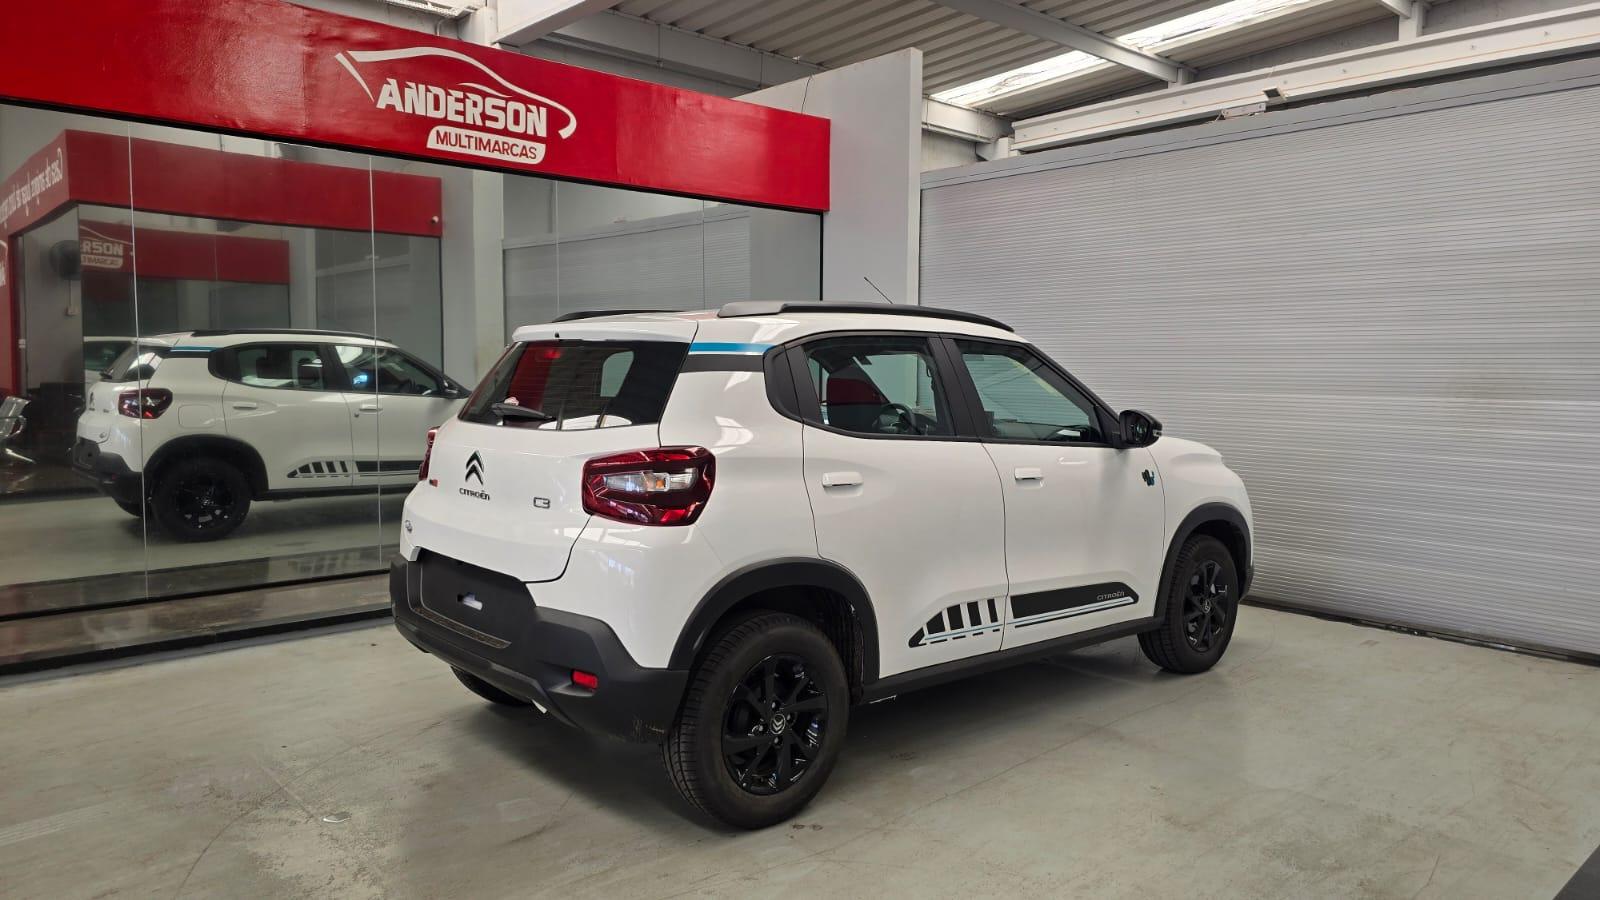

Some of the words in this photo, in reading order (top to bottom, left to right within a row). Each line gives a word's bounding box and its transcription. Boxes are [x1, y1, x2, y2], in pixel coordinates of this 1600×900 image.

[376, 78, 547, 137] ANDERSON
[435, 130, 537, 160] MULTIMARCAS
[80, 240, 123, 256] RSON
